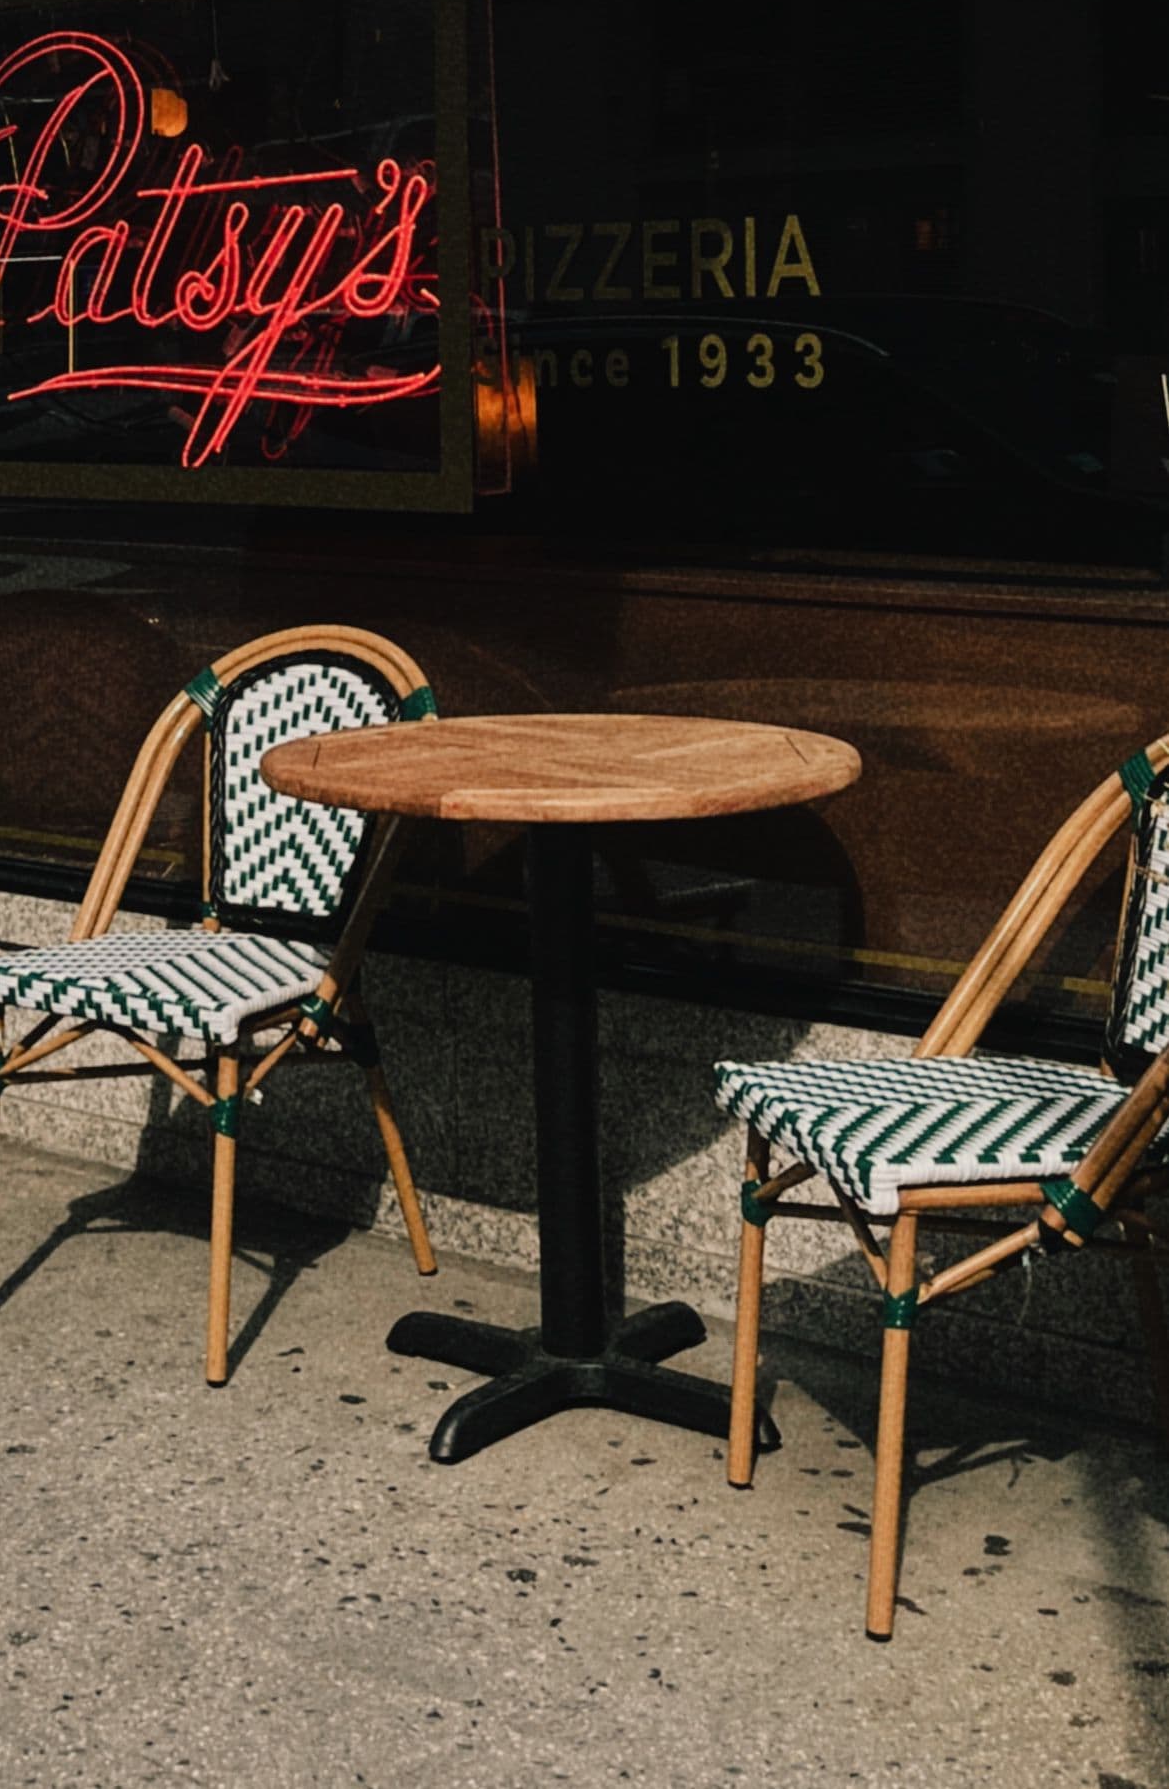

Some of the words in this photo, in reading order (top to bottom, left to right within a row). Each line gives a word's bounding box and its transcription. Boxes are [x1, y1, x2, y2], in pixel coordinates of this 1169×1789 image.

[479, 214, 822, 303] PIZZERIA
[474, 332, 631, 390] Since
[661, 332, 825, 389] 1933
